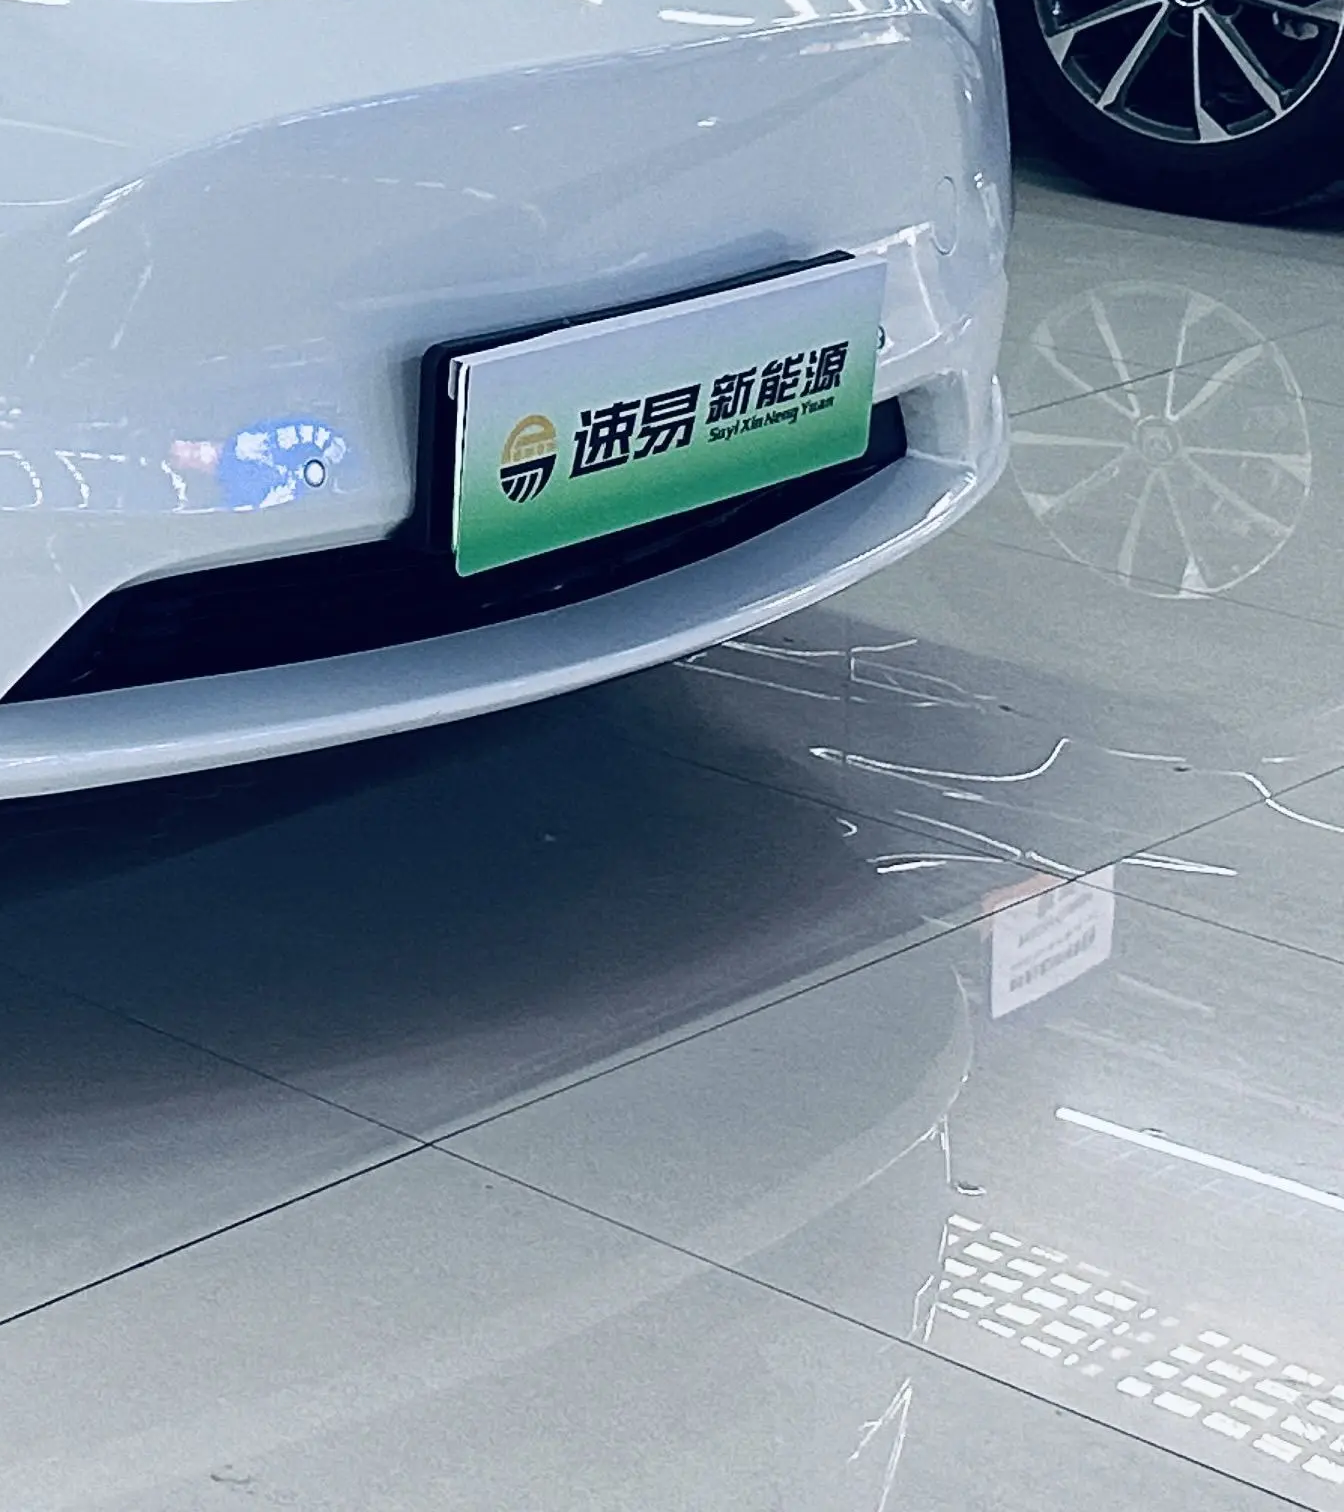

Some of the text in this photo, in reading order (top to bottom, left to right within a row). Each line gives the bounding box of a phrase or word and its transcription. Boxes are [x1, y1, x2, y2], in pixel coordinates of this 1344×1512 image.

[569, 341, 850, 478] 速易 新能源
